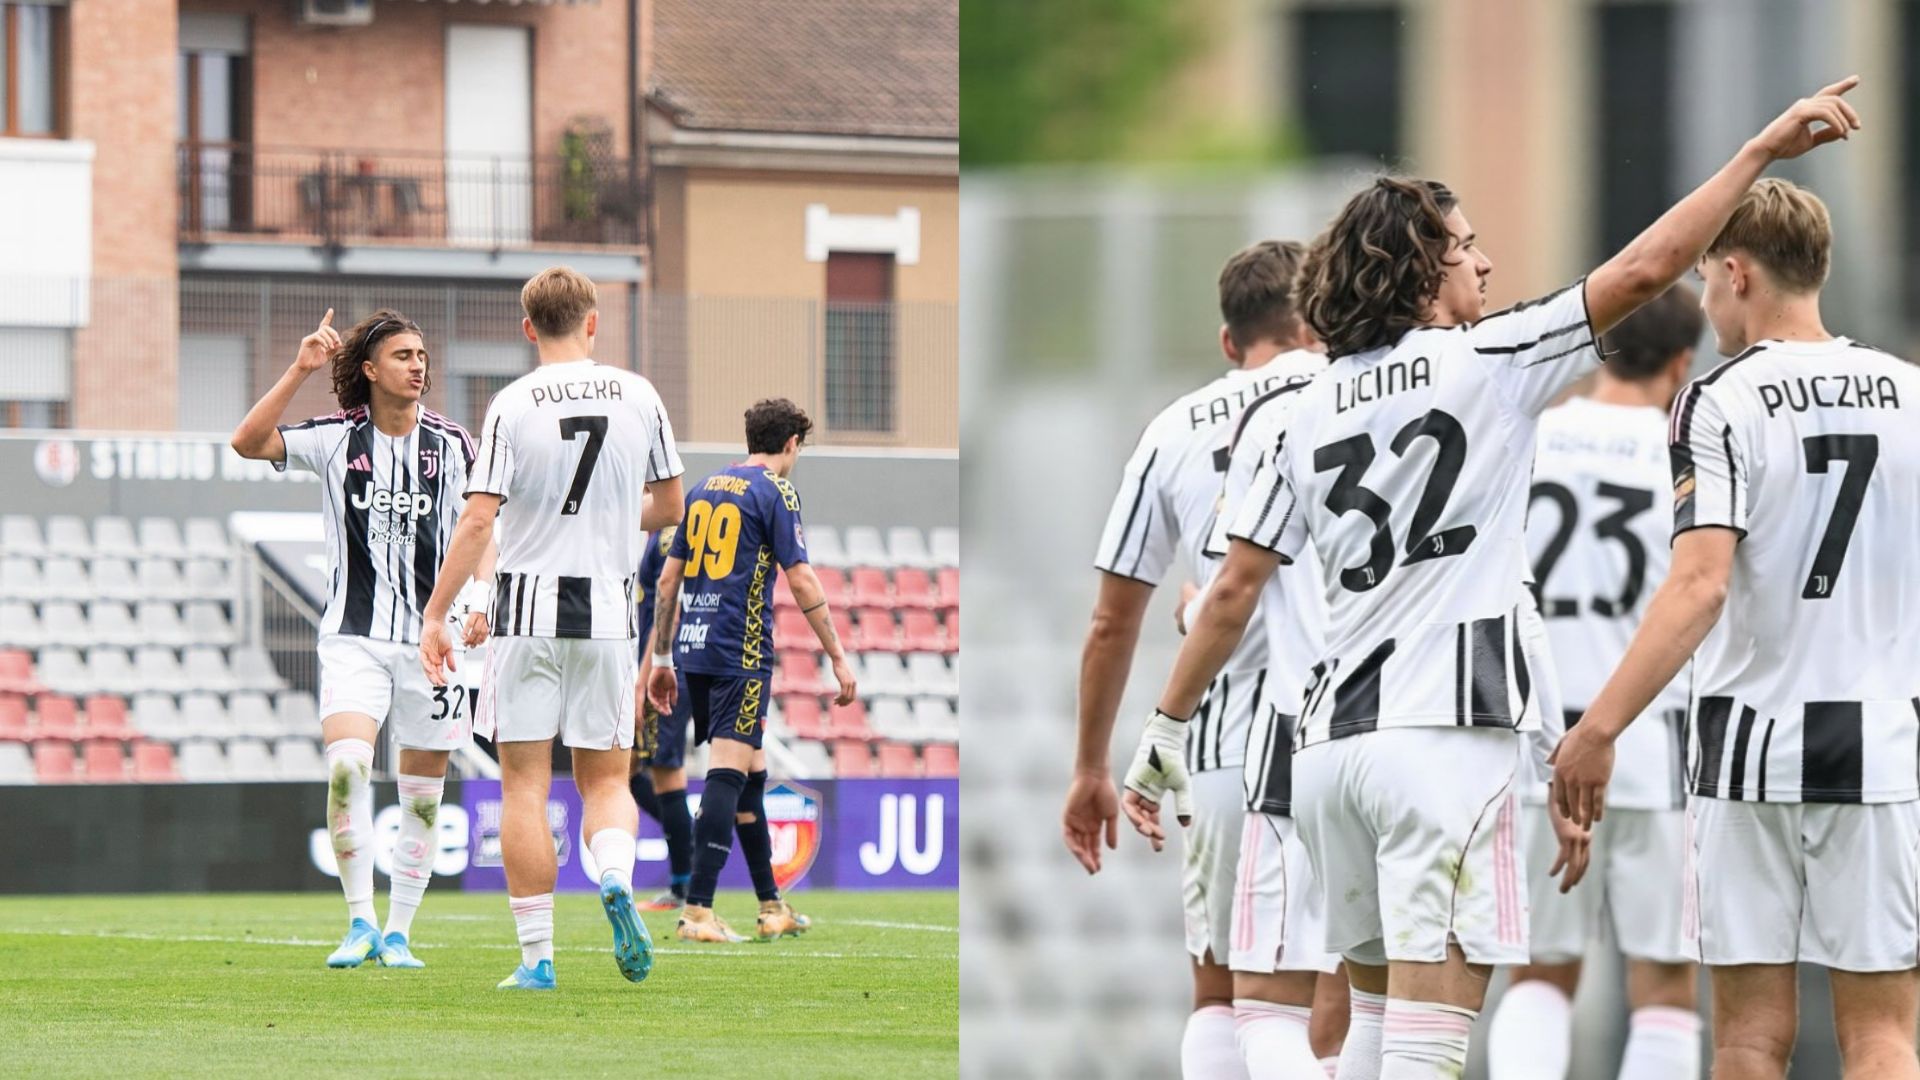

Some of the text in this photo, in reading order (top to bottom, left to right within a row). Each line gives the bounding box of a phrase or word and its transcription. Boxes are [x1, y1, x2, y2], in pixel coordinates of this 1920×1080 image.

[531, 379, 623, 407] PUCZKA
[1336, 356, 1431, 415] LICINA
[1759, 374, 1900, 418] PUCZKA
[352, 481, 433, 521] Jeep
[559, 416, 609, 516] 7
[1313, 408, 1477, 593] 32
[684, 499, 742, 581] 99
[1528, 480, 1655, 619] 23
[1802, 434, 1879, 599] 7
[679, 617, 709, 642] mia
[431, 684, 466, 721] 32
[859, 793, 945, 876] JU
